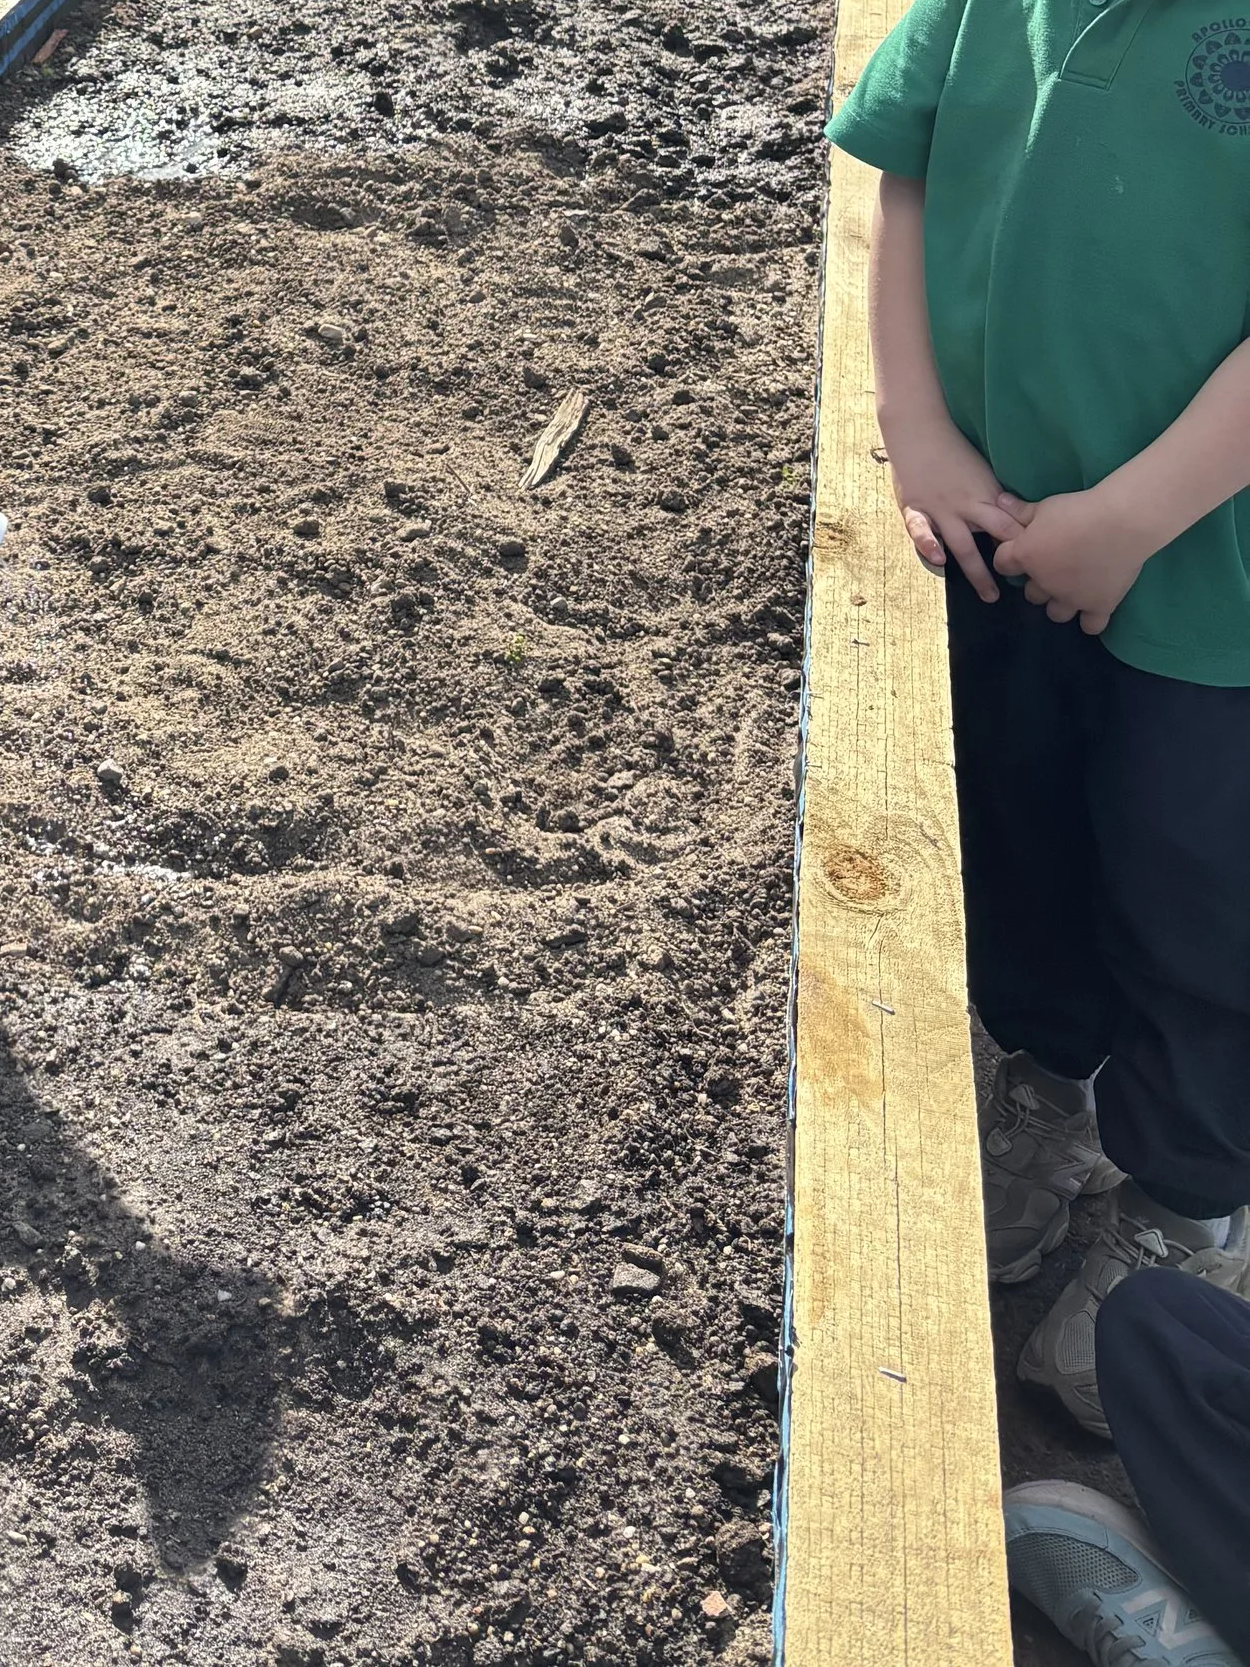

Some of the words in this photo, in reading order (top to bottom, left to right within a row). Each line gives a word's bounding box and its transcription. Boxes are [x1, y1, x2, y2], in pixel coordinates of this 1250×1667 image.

[1191, 18, 1247, 43] APOLLO
[1174, 80, 1216, 130] PRIMARY
[1219, 124, 1250, 136] SCH
